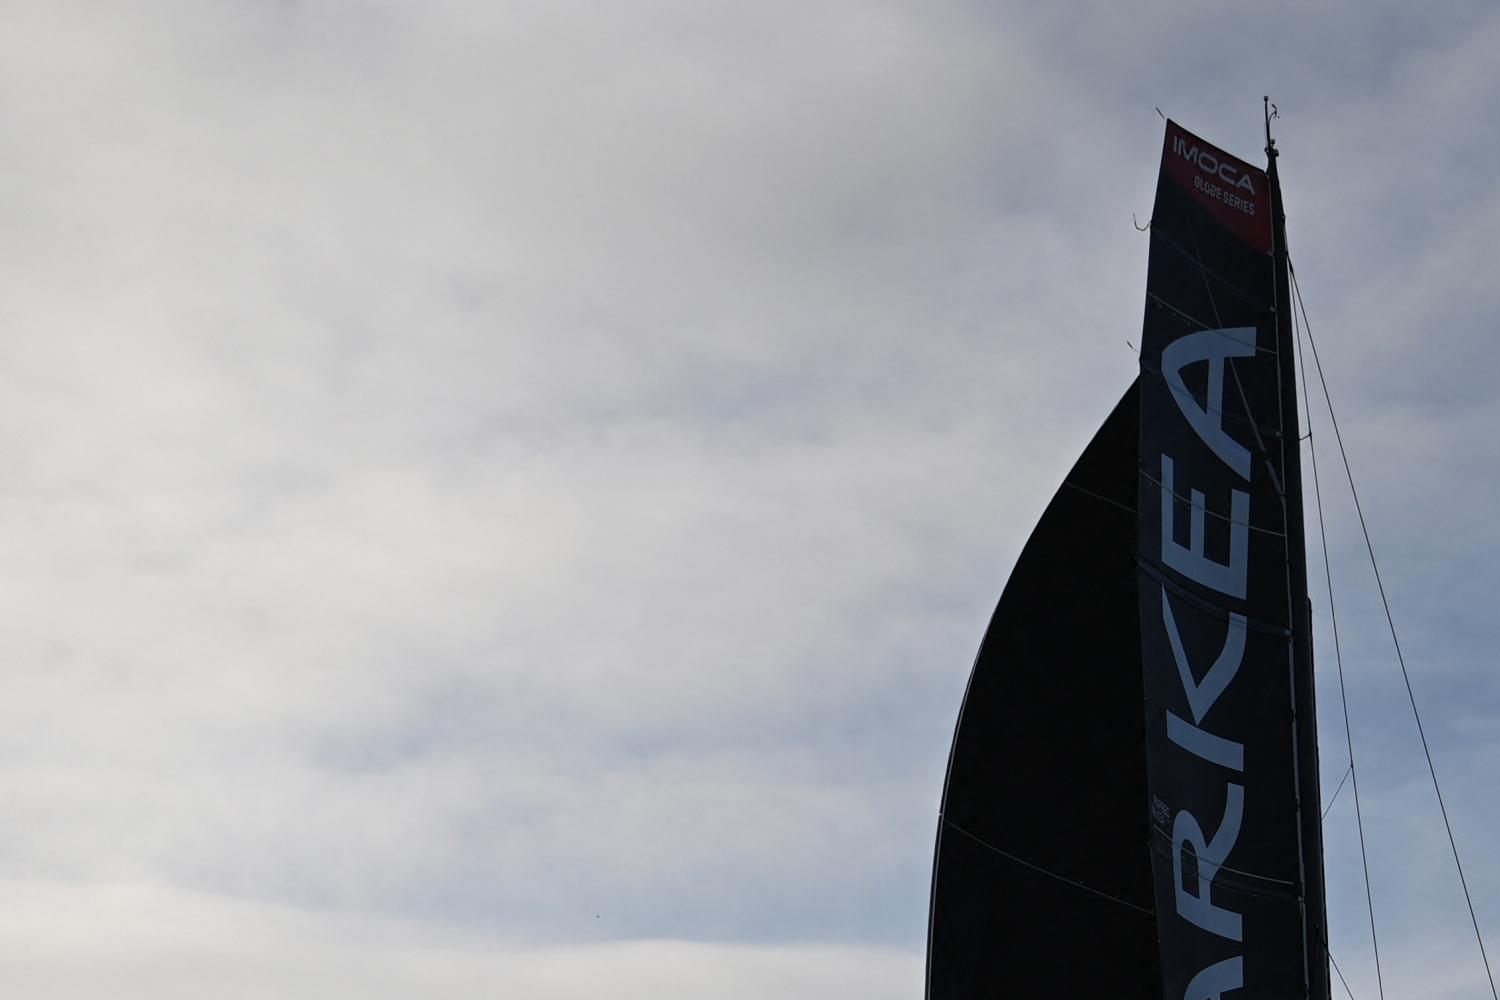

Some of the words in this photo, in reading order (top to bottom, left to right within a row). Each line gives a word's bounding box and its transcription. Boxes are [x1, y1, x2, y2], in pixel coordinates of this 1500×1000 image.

[1172, 135, 1256, 195] IMOCA
[1194, 175, 1222, 200] GLOBE
[1223, 191, 1255, 216] SERIES
